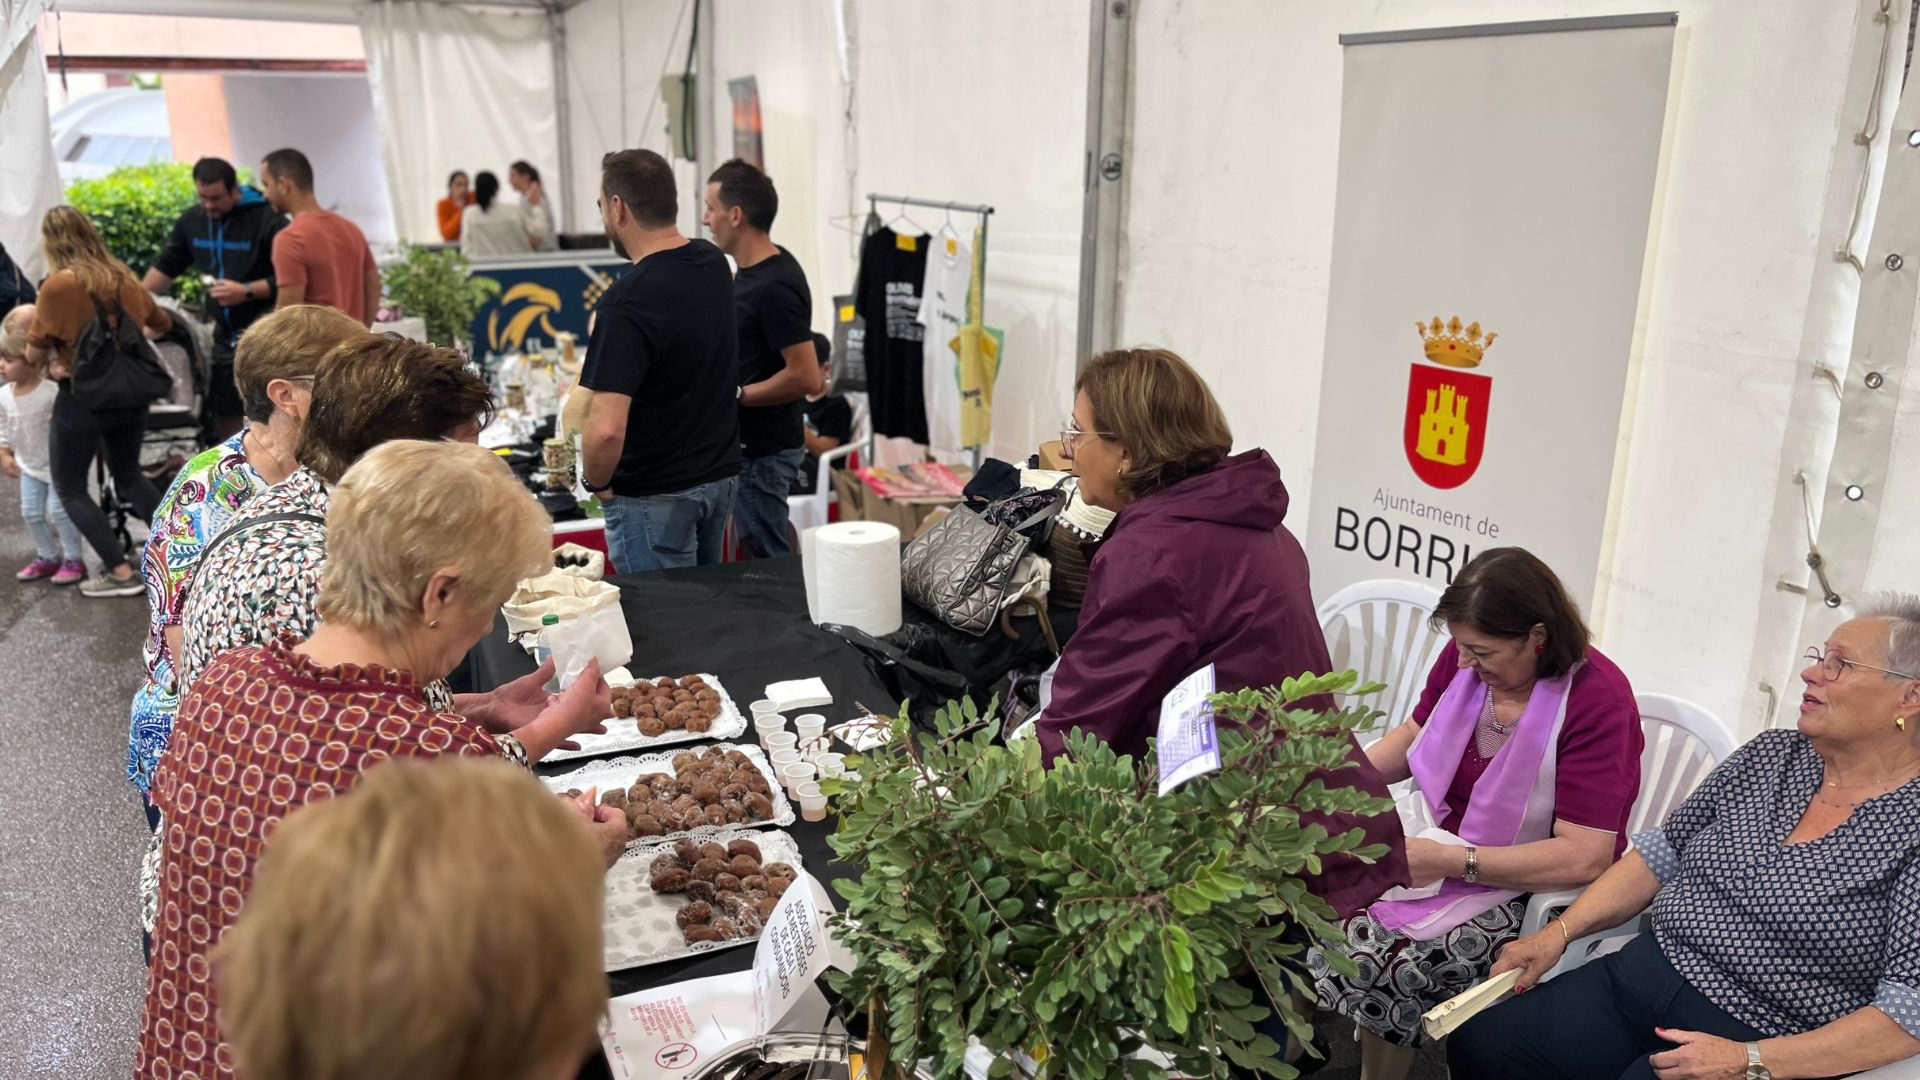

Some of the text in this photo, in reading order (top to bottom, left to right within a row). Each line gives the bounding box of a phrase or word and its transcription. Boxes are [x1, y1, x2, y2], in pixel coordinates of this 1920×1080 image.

[1373, 488, 1499, 539] Ajuntament de
[780, 927, 789, 944] DE
[784, 941, 795, 968] CASA
[785, 903, 808, 977] DE MESTRESSES
[795, 899, 817, 956] ASSOCIACIÓ
[771, 926, 791, 999] CONSUMIDORS
